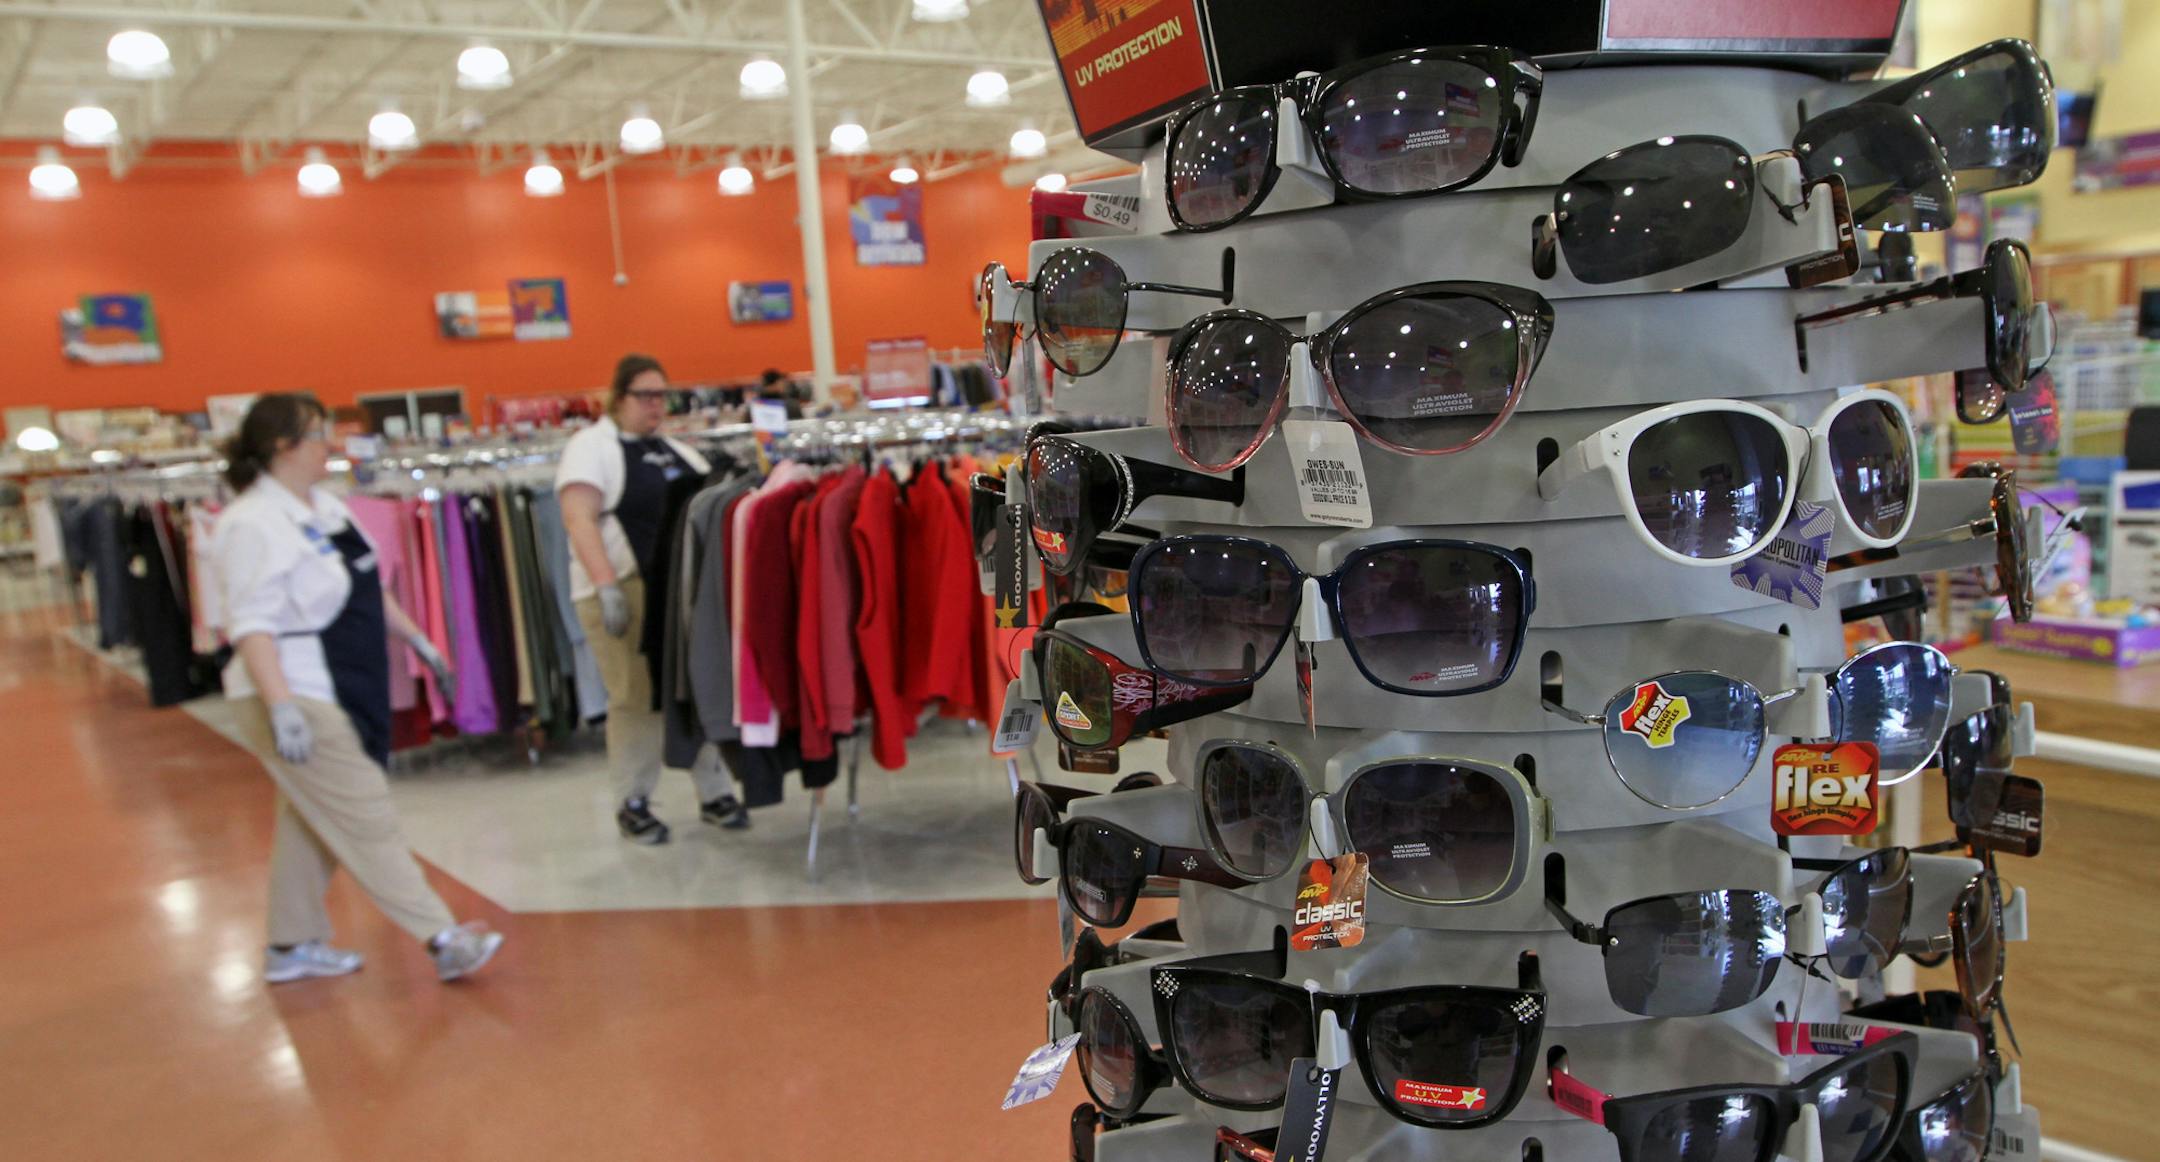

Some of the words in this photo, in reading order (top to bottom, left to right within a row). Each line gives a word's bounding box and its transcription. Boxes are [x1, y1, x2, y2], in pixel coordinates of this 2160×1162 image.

[1075, 62, 1094, 87] UV
[1094, 15, 1183, 77] PROTECTION
[1405, 132, 1451, 144] ULTRAVIOLET
[1408, 128, 1447, 138] MAXIMUM
[1406, 139, 1450, 149] PROTECTION
[1093, 203, 1130, 225] $0.49
[1412, 397, 1474, 410] ULTRAVIOLET
[1416, 392, 1468, 403] MAXIMUM
[1413, 404, 1473, 416] PROTECTION
[1014, 504, 1022, 607] HOLLYWOOD
[1634, 693, 1672, 735] flex
[1653, 709, 1672, 732] HINGE
[1657, 708, 1680, 738] TEMPLES
[1812, 763, 1840, 774] RE
[1775, 764, 1873, 812] flex
[1295, 896, 1363, 926] classic
[1302, 931, 1351, 942] PROTECTION
[1405, 1083, 1453, 1094] MAXIMUM
[1400, 1093, 1456, 1106] PROTECTION
